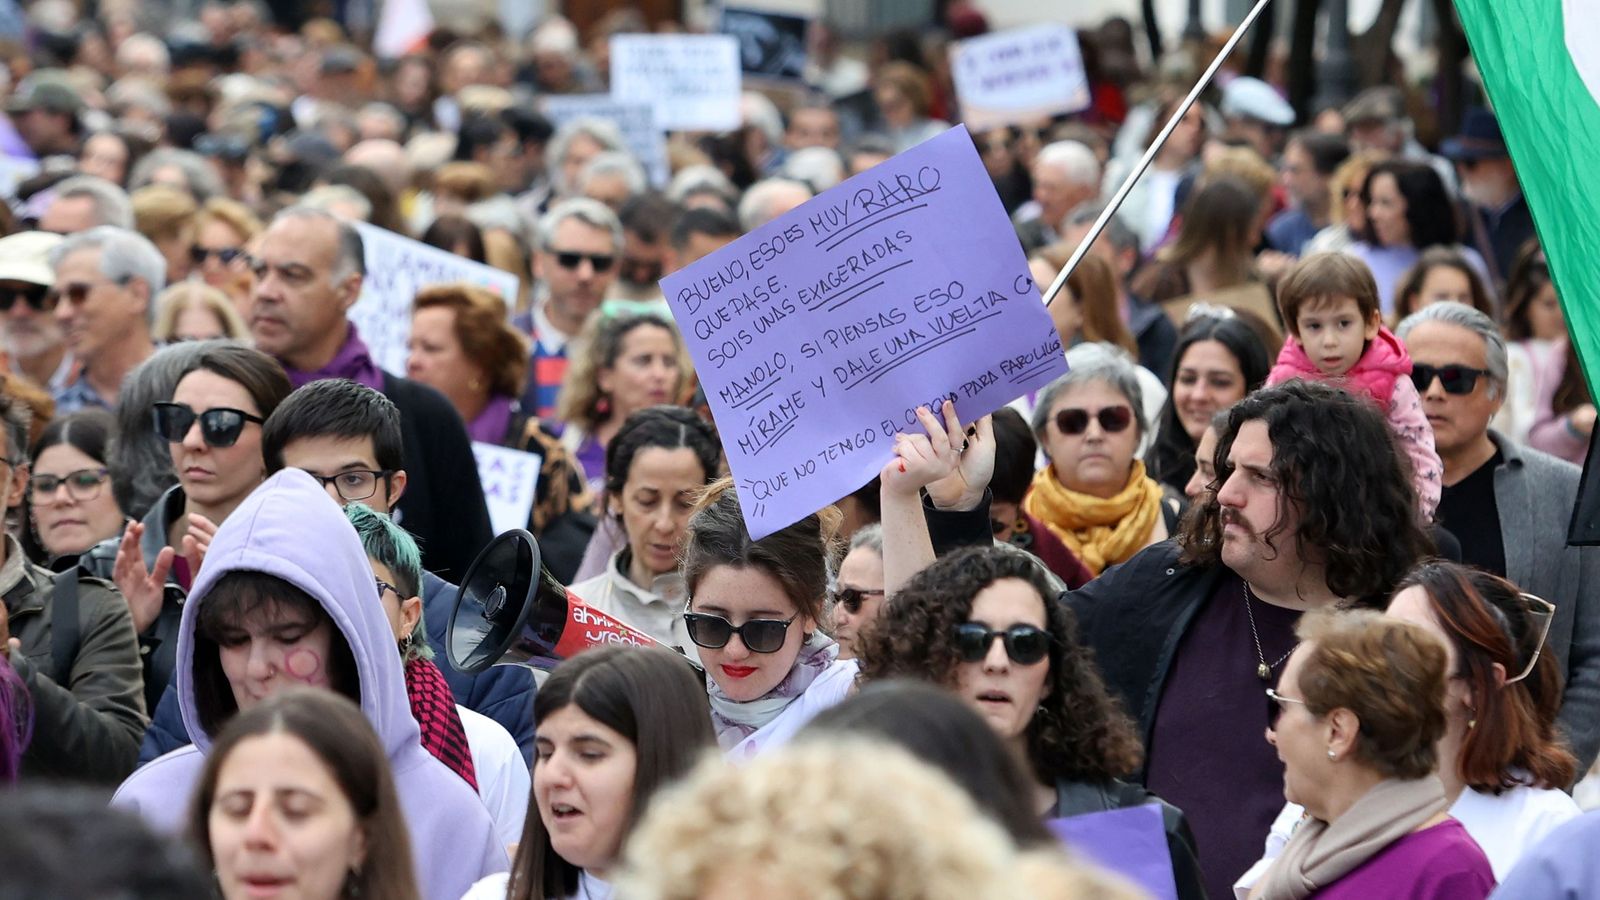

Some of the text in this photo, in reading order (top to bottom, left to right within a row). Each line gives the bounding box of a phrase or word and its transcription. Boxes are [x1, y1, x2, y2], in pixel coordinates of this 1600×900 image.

[678, 259, 750, 316] BUENO,
[808, 199, 849, 235] MUY
[852, 165, 941, 214] RARO
[707, 230, 913, 369] SOIS UNAS EXAGERADAS
[694, 274, 788, 340] QUE PASE.
[719, 280, 964, 404] MANOLO, SI PIENSAS ESO
[737, 290, 1008, 455] MÍRAME Y DALE UNA VUELTA
[793, 459, 816, 480] NO
[817, 428, 877, 465] TENGO
[880, 418, 903, 438] EL
[959, 370, 999, 399] PARA
